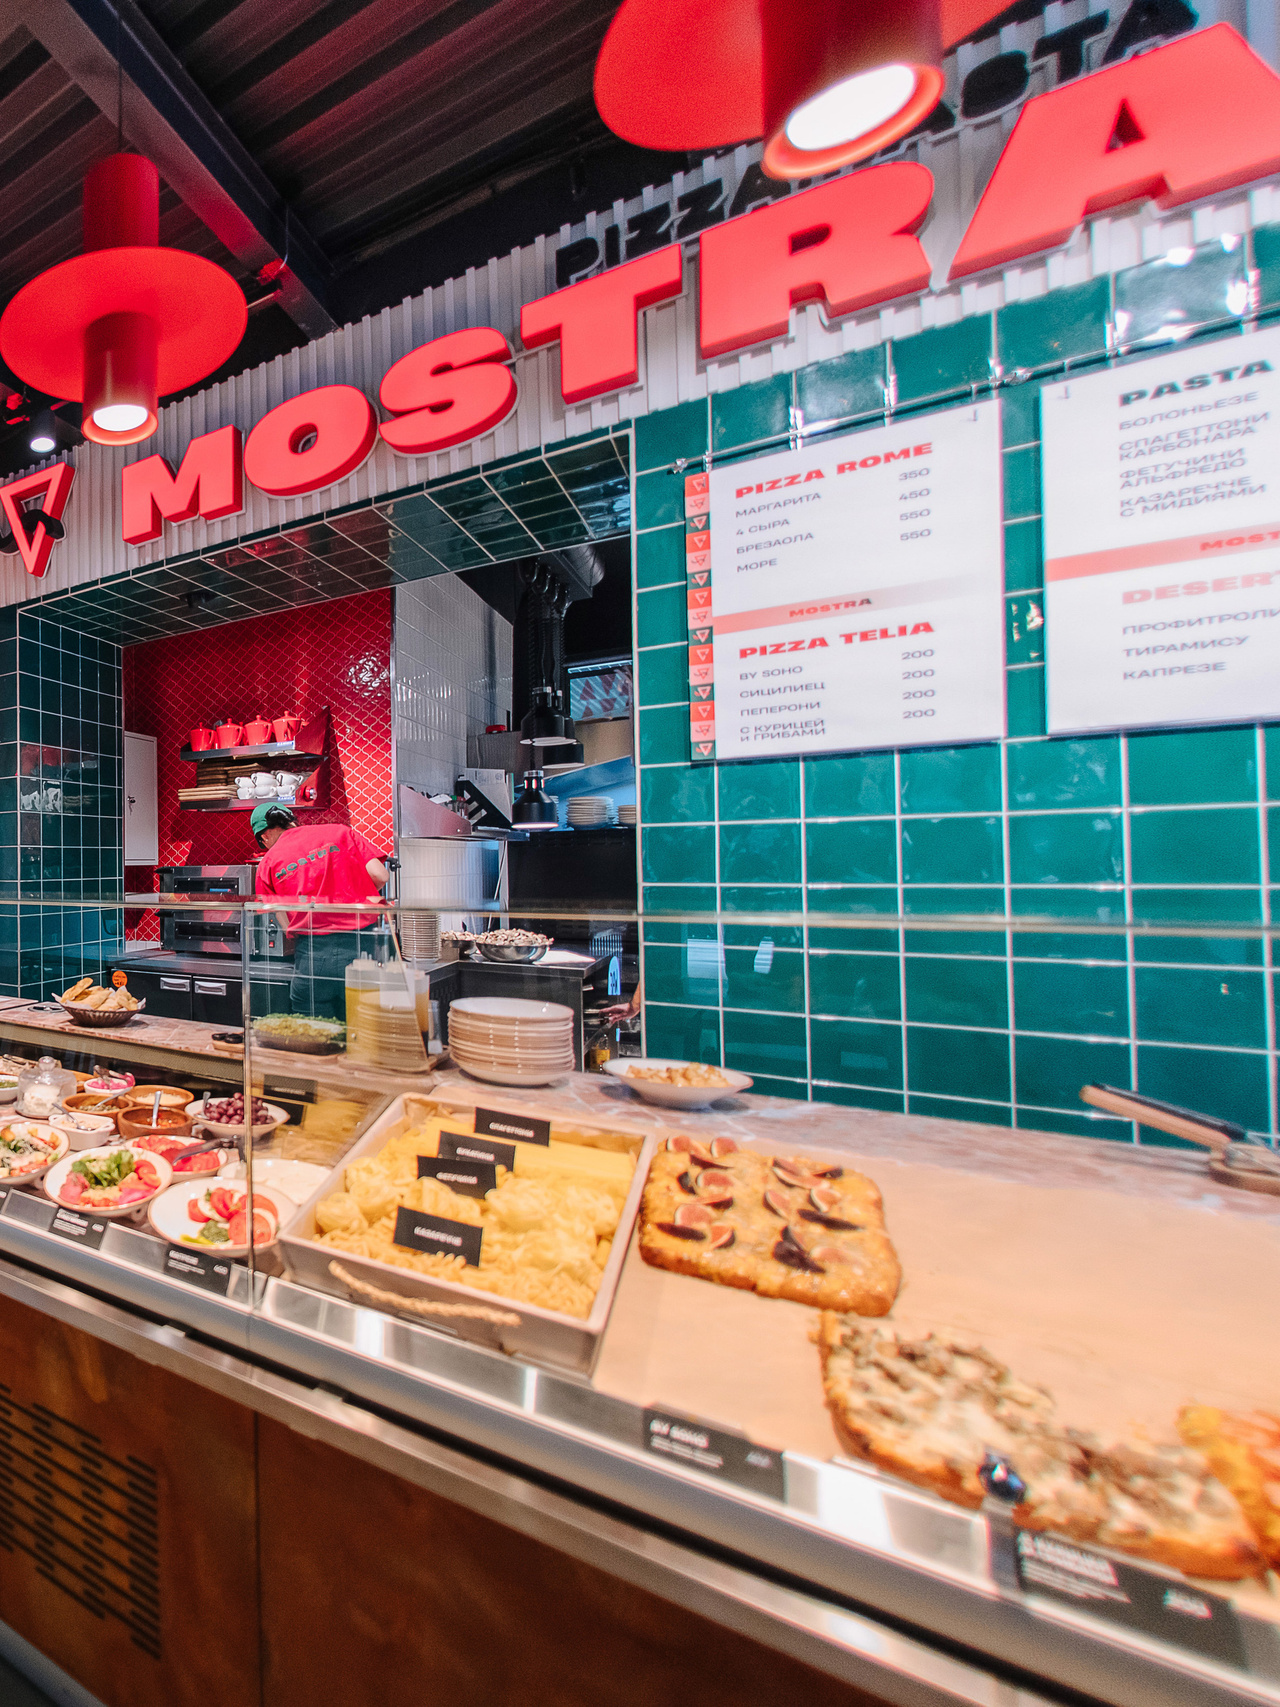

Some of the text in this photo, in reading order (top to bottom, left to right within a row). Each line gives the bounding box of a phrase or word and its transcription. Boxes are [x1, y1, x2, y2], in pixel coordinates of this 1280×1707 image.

[122, 22, 1280, 546] MOSTRA
[1119, 359, 1275, 407] PASTA
[1119, 391, 1260, 430] БОЛОНЬЕЗЕ
[1119, 411, 1269, 451] СПАГЕТТОНИ
[1120, 426, 1257, 461] КАРБОНАРА
[735, 442, 933, 499] PIZZA ROME
[1120, 447, 1245, 479] ФЕТУЧИНИ
[898, 467, 931, 481] 350
[1120, 458, 1247, 489] АЛЬФРЕДО
[899, 488, 931, 502] 450
[1120, 476, 1252, 507] КАЗАРЕЧЧЕ
[1142, 484, 1267, 514] МИДИЯМИ
[735, 493, 822, 518] МАРГАРИТА
[899, 508, 932, 521] 550
[748, 518, 791, 534] СЫРА
[900, 528, 932, 541] 550
[736, 532, 815, 554] БРЕЗАОЛА
[736, 557, 778, 573] МОРЕ
[1122, 569, 1280, 605] DESER
[789, 597, 873, 618] MOSTRA
[739, 621, 935, 659] PIZZA TELIA
[1123, 635, 1250, 657] ТИРАМИСУ
[901, 649, 935, 661] 200
[739, 665, 803, 681] BY SOHO
[902, 668, 936, 680] 200
[1123, 661, 1228, 680] КАПРЕЗЕ
[739, 682, 826, 699] СИЦИЛИЕЦ
[902, 689, 936, 700] 200
[740, 701, 821, 717] ПЕПЕРОНИ
[902, 708, 937, 720] 200
[754, 717, 826, 734] КУРИЦЕЙ
[754, 727, 827, 741] ГРИБАМИ
